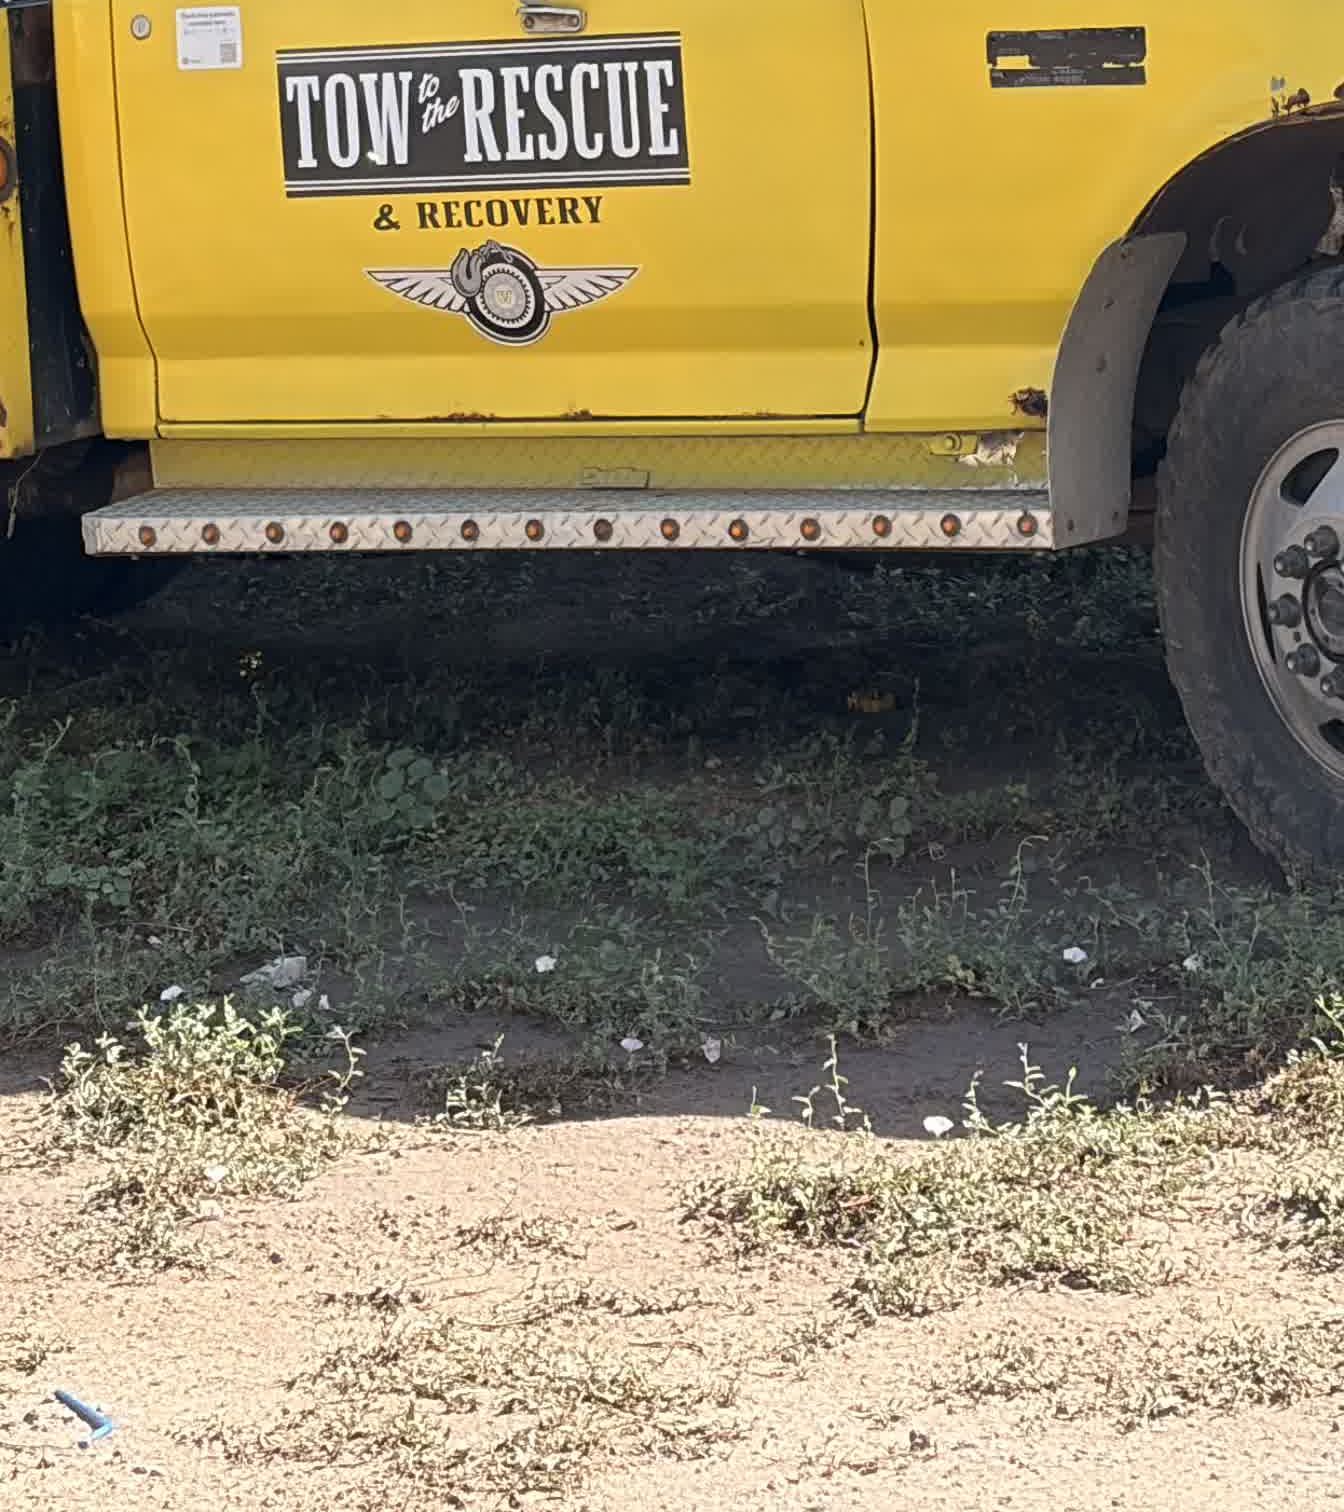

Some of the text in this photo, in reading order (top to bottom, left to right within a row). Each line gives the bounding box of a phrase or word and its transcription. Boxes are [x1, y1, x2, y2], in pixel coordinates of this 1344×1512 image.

[286, 60, 679, 169] TOW to the RESCUE
[373, 196, 603, 231] & RECOVERY
